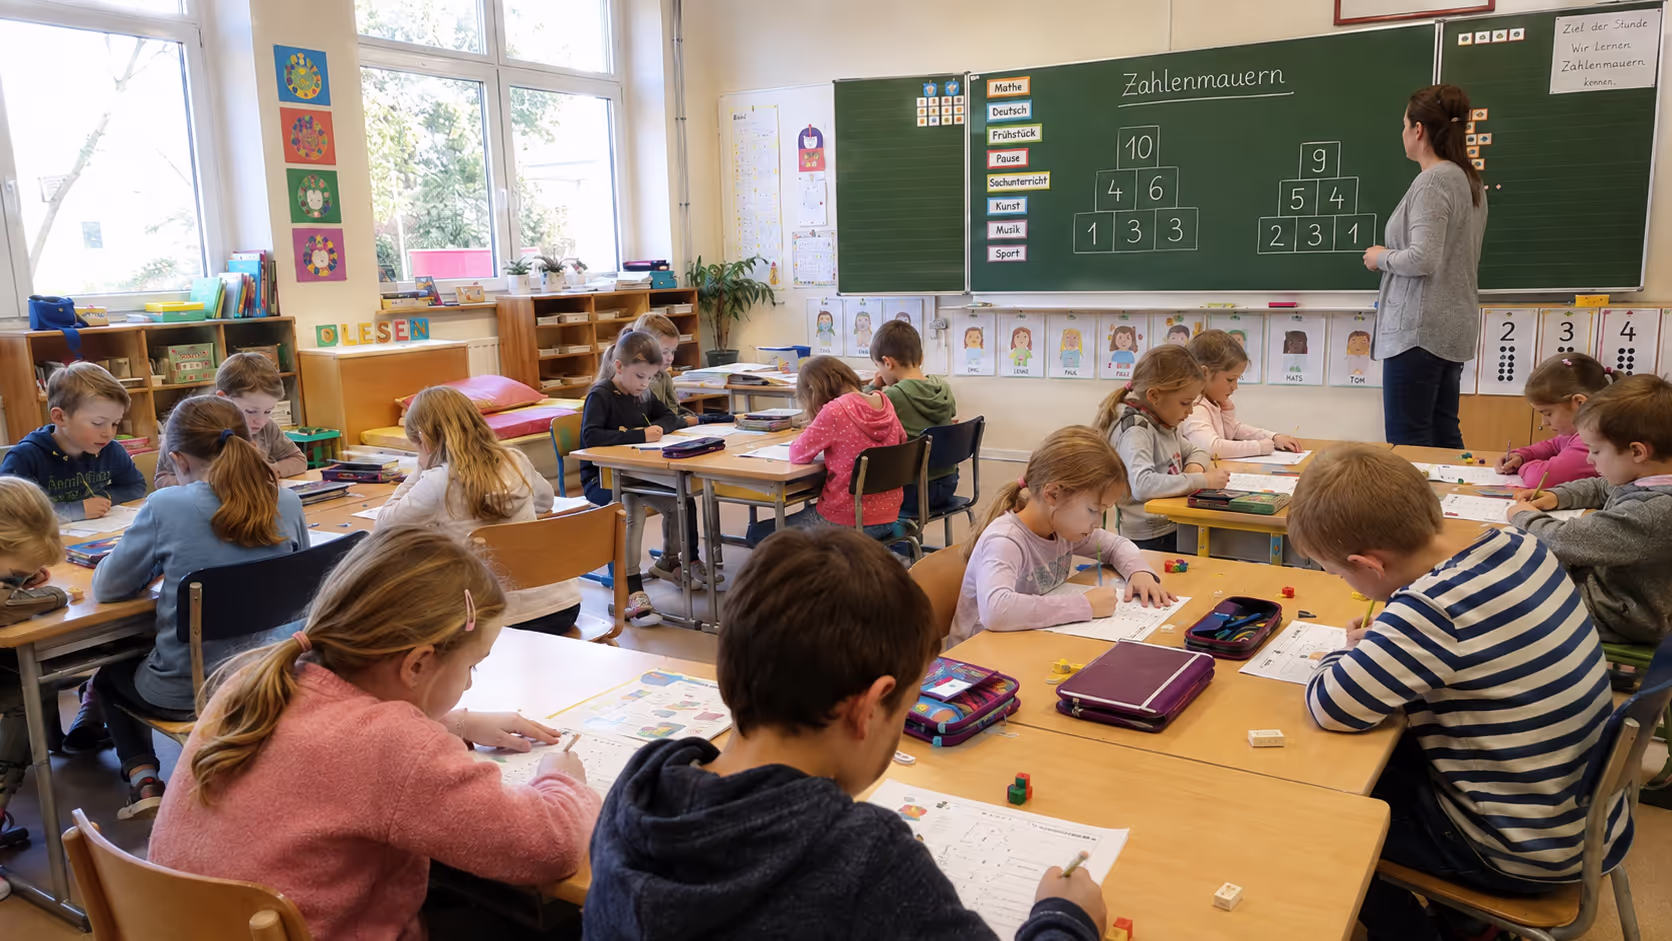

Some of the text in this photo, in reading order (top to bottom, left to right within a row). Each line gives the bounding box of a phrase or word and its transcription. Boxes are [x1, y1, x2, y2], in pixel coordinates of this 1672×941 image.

[1562, 18, 1649, 34] Ziel der Stunde
[1571, 43, 1589, 53] Wir
[1561, 59, 1646, 72] Zahlenmauern
[994, 83, 1022, 92] Mathe
[1122, 69, 1285, 97] Zahlenmauern
[992, 105, 1027, 116] Deutsch
[992, 128, 1036, 140] Frühstück
[1125, 135, 1153, 160] 10
[996, 154, 1020, 163] Pause
[1312, 148, 1326, 173] 9
[1107, 175, 1163, 202] 4 6
[995, 202, 1020, 210] Kunst
[1290, 186, 1345, 210] 5 4
[995, 225, 1020, 234] Musik
[1087, 218, 1183, 245] 1 3 3
[1269, 222, 1359, 246] 2 3 1
[995, 249, 1020, 259] Sport
[341, 320, 427, 346] LESEN
[1500, 321, 1515, 342] 2
[1559, 321, 1574, 342] 3
[1619, 320, 1637, 342] 4
[1350, 376, 1366, 384] TOM
